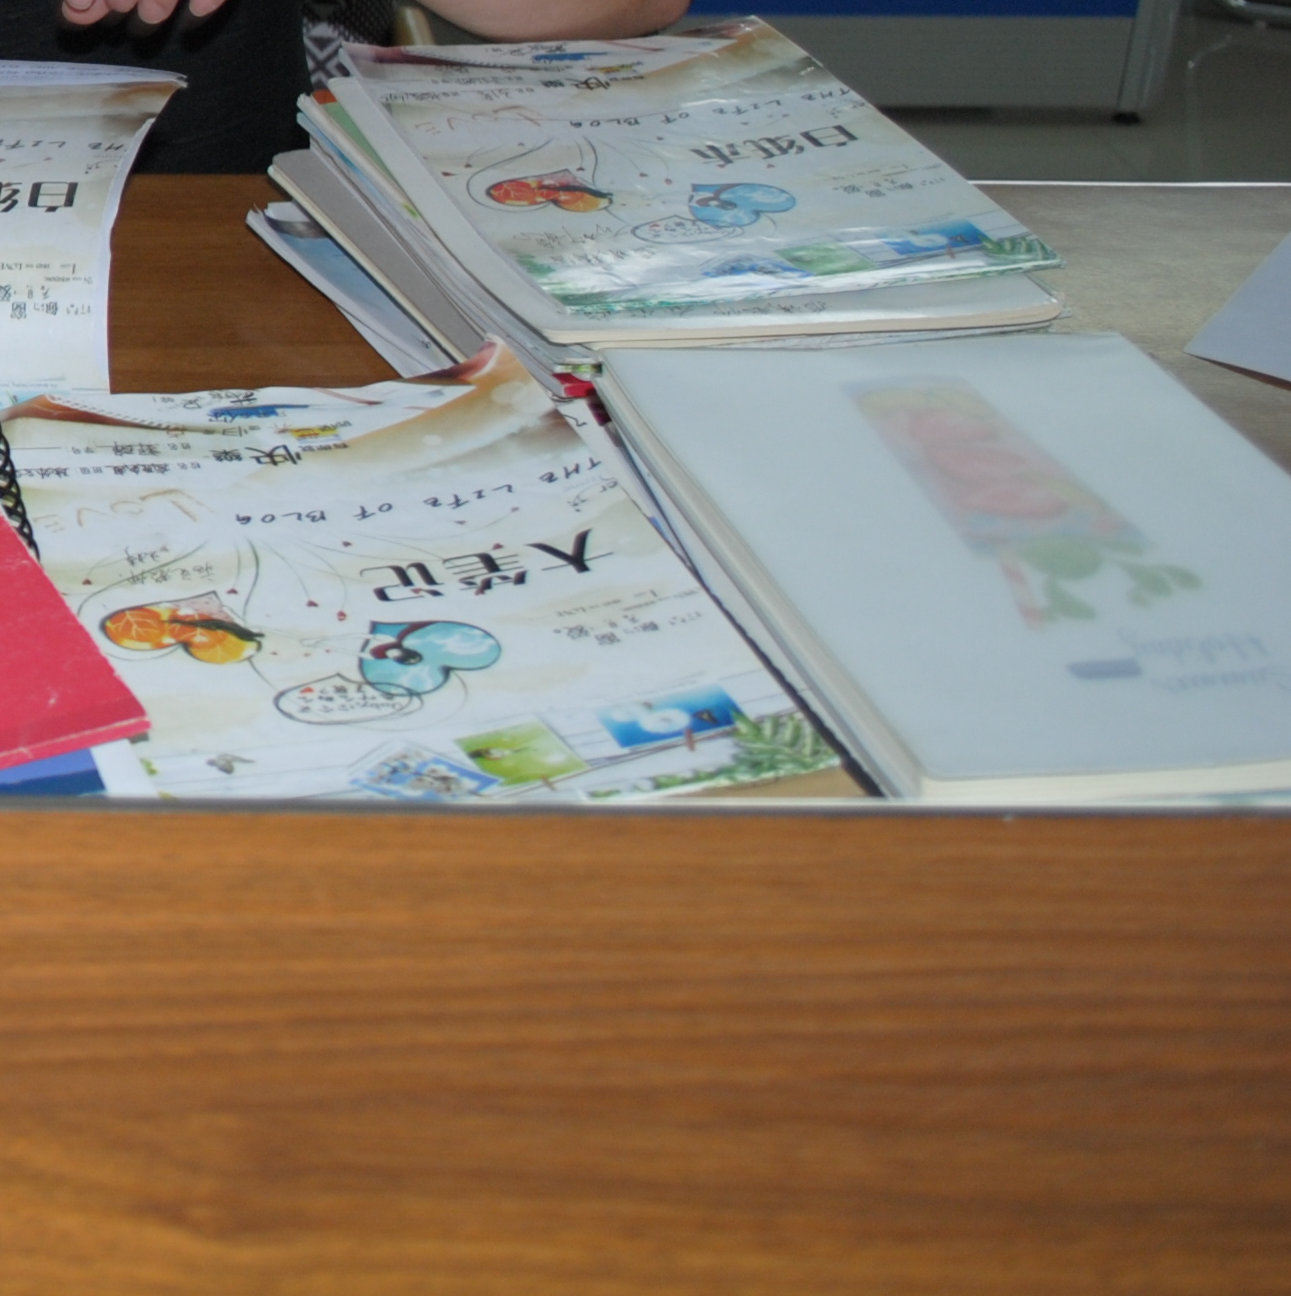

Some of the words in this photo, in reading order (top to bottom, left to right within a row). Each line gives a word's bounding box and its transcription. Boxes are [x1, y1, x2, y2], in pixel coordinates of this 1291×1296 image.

[689, 124, 860, 165] 白纸本
[235, 506, 327, 526] BLOG
[352, 502, 393, 522] OF
[359, 528, 614, 602] 大笔记
